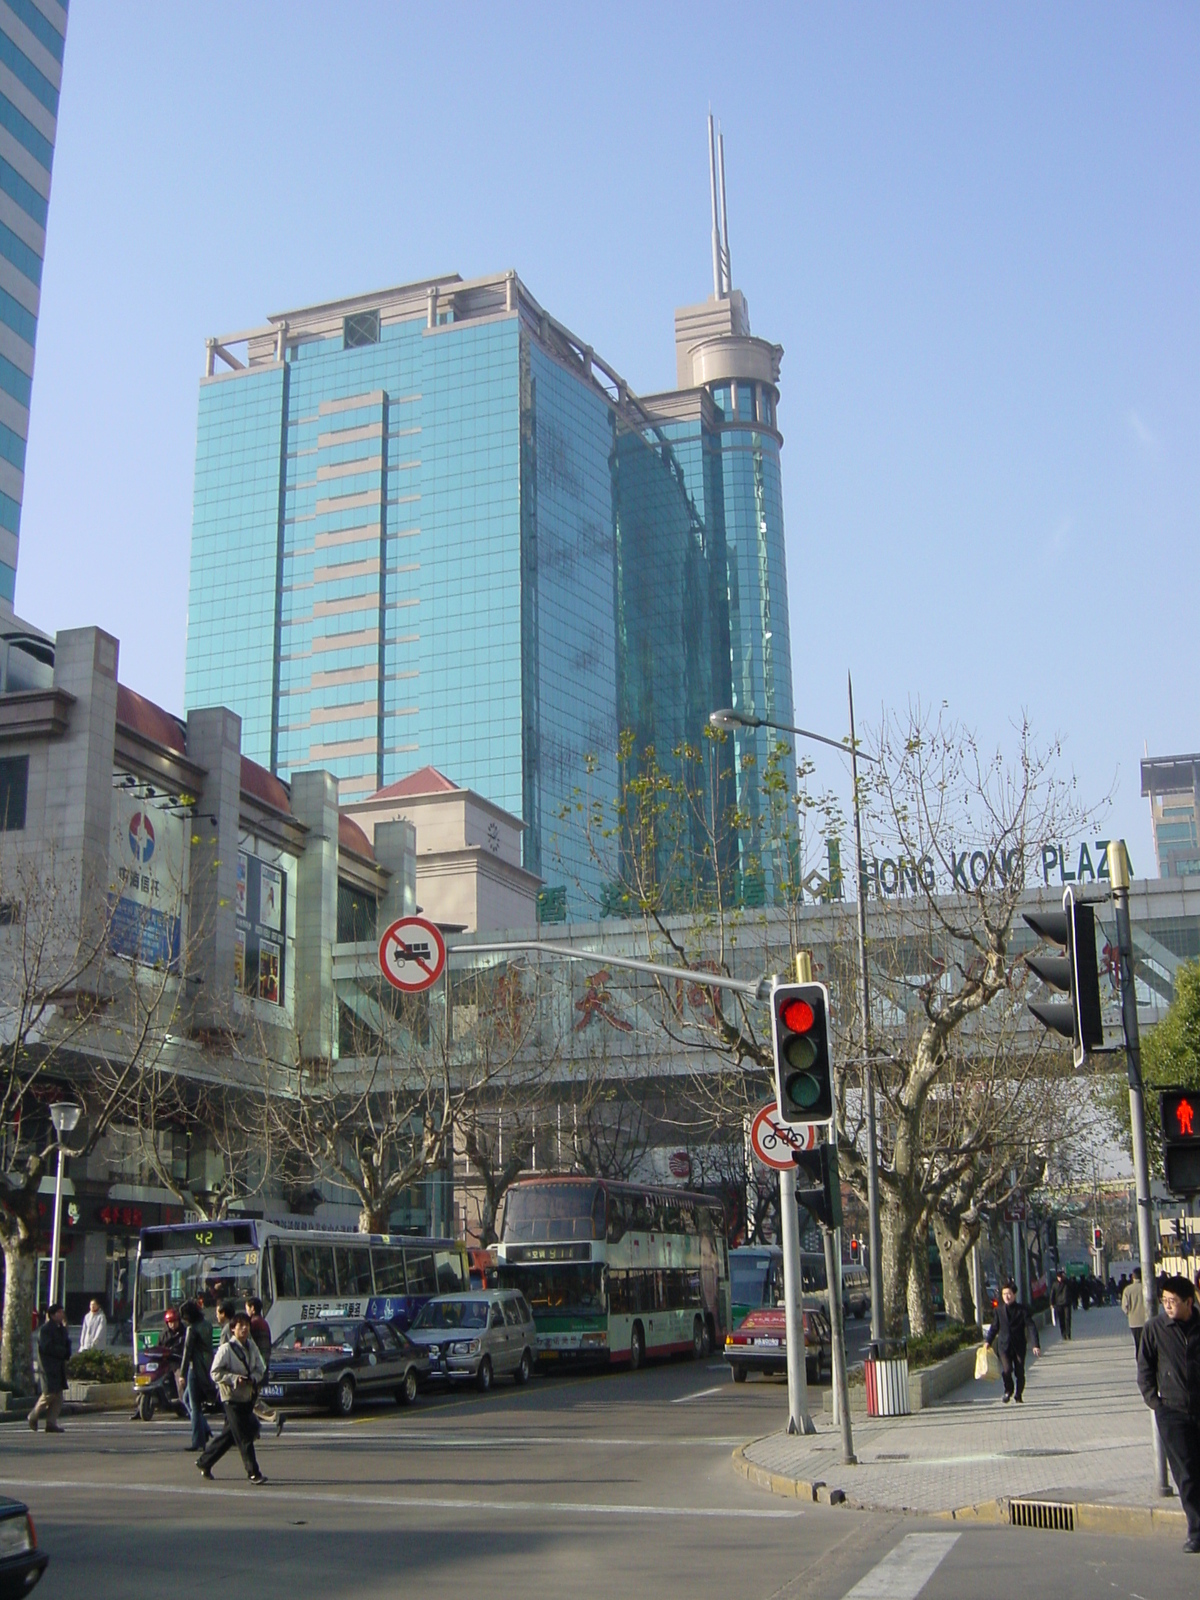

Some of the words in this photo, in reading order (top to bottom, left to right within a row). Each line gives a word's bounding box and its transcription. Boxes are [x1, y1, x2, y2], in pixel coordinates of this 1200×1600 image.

[862, 856, 935, 896] HONG
[952, 846, 1025, 890] KONG
[195, 1231, 213, 1245] 42
